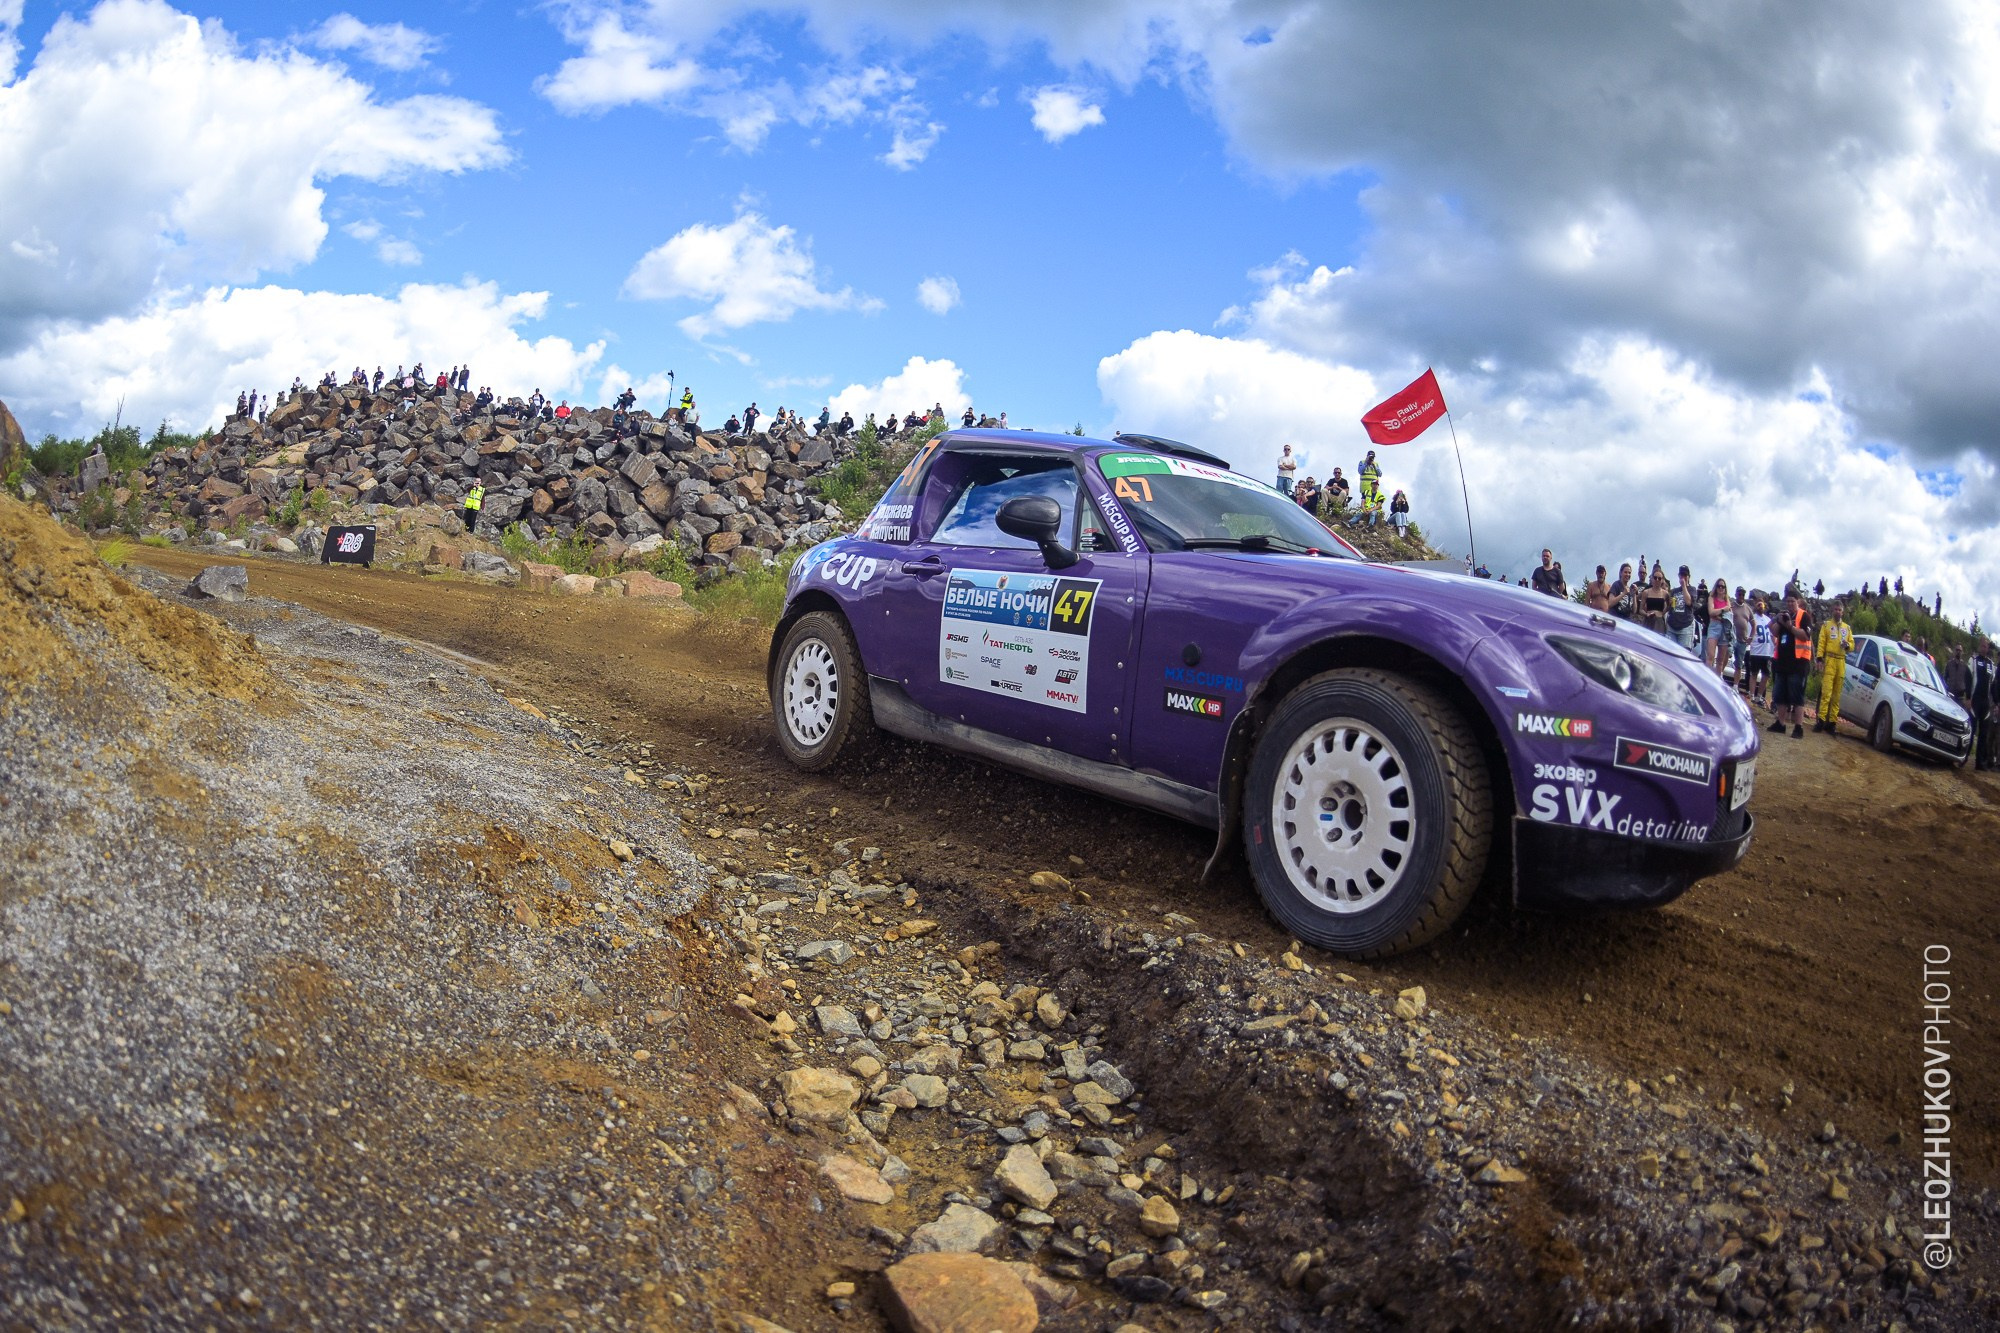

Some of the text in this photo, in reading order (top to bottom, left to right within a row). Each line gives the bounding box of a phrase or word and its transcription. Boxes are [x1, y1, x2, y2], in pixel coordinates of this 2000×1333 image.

[1397, 402, 1418, 417] Rally
[1114, 476, 1153, 502] 47
[1097, 492, 1140, 553] MX5CUP.RU
[339, 532, 364, 553] R8
[821, 552, 877, 590] CUP
[1027, 578, 1053, 591] 2026
[947, 587, 998, 608] БЕЛЫЕ
[1000, 591, 1049, 614] НОЧИ
[1053, 589, 1093, 624] 47
[989, 639, 1033, 653] ТАТНЕФТЬ
[980, 656, 1001, 666] SPACE
[1167, 692, 1220, 713] MAX HP
[1517, 712, 1590, 735] MAX HP
[1648, 750, 1705, 777] YOKOHAMA
[1529, 784, 1708, 842] SVX detailing
